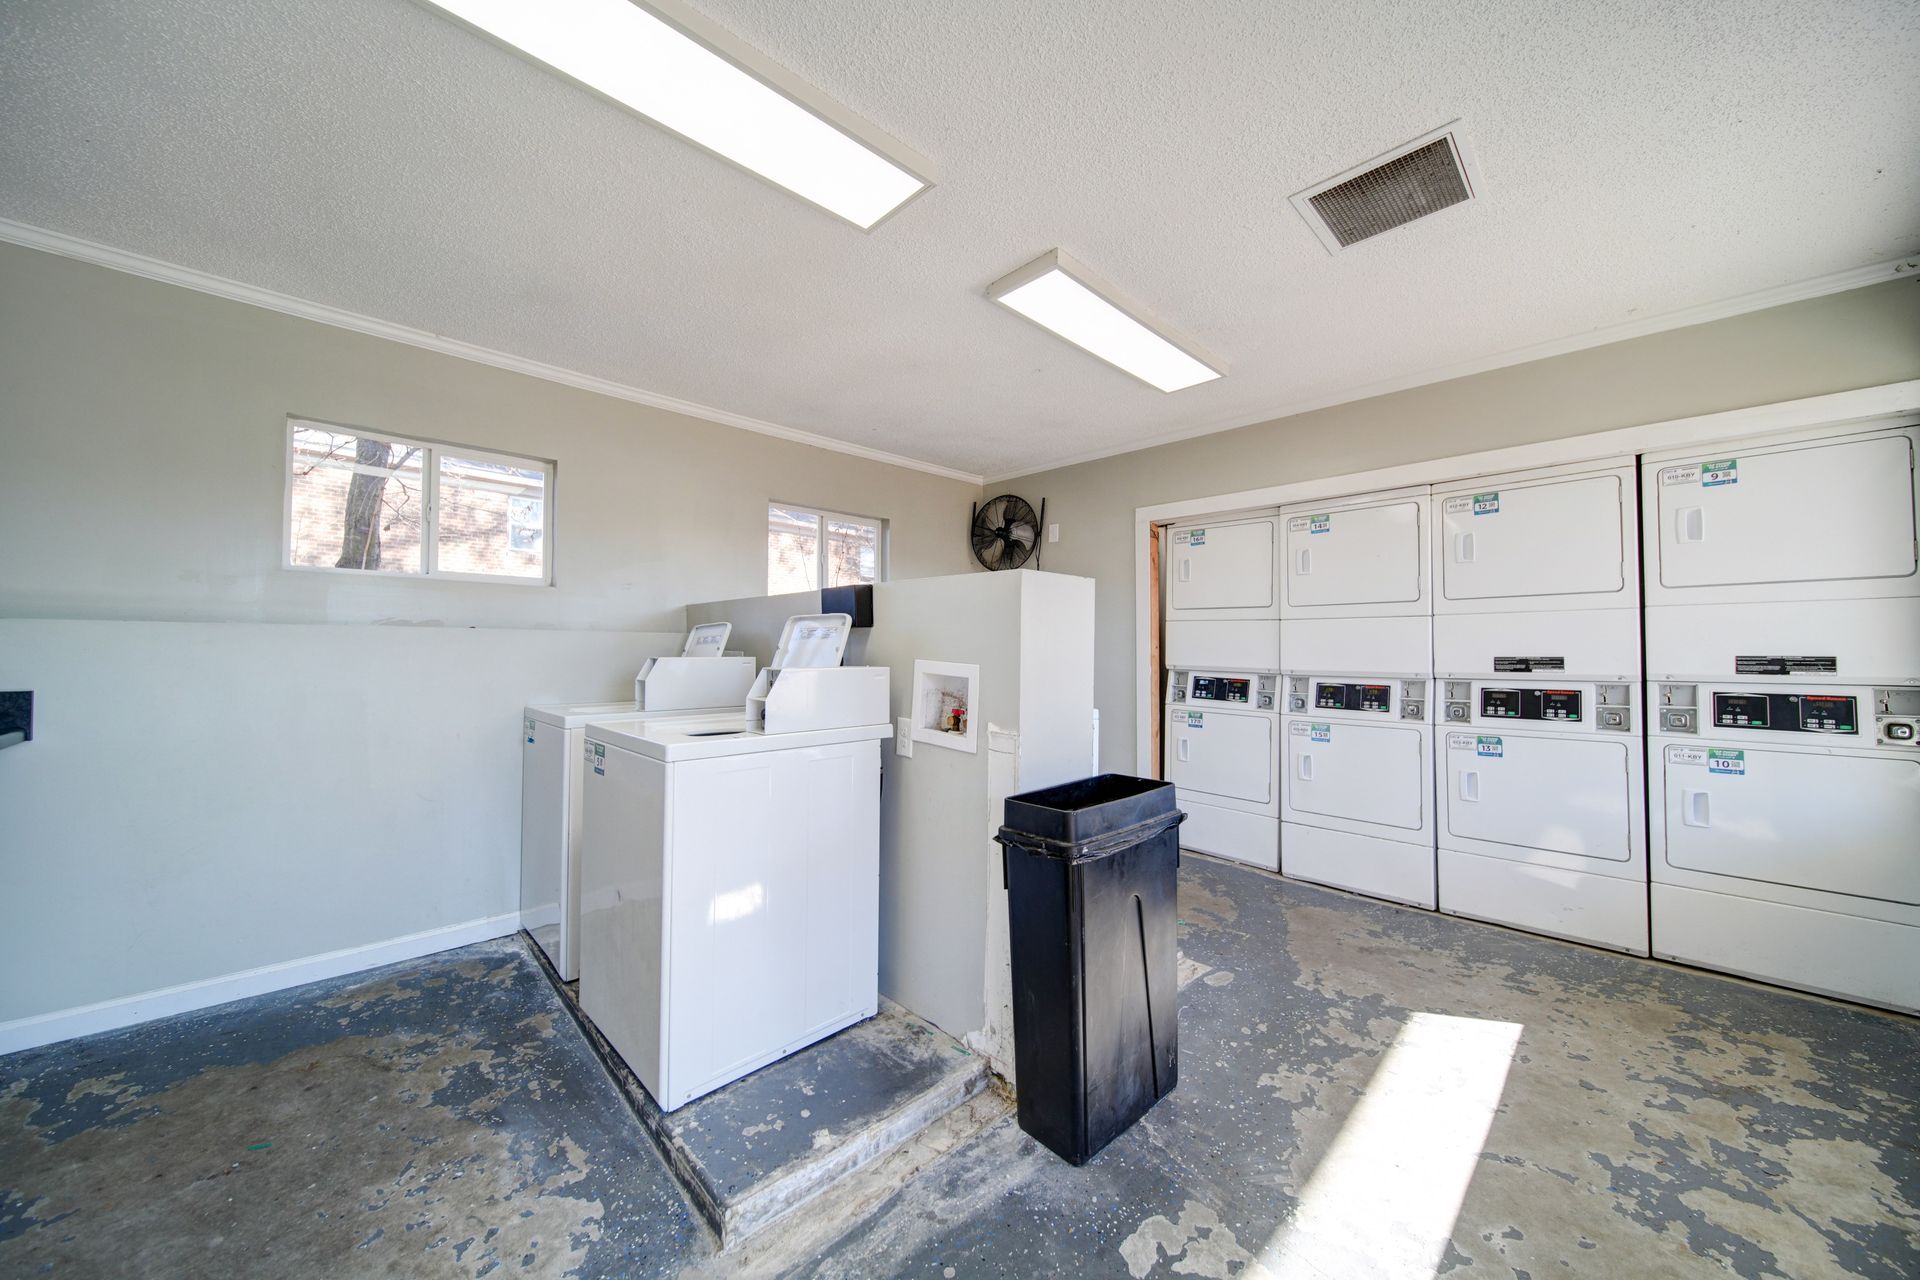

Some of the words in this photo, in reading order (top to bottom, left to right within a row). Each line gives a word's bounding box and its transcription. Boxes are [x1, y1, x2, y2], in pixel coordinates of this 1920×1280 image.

[1710, 472, 1719, 481] 9
[1478, 503, 1488, 511] 12
[1713, 760, 1730, 769] 10
